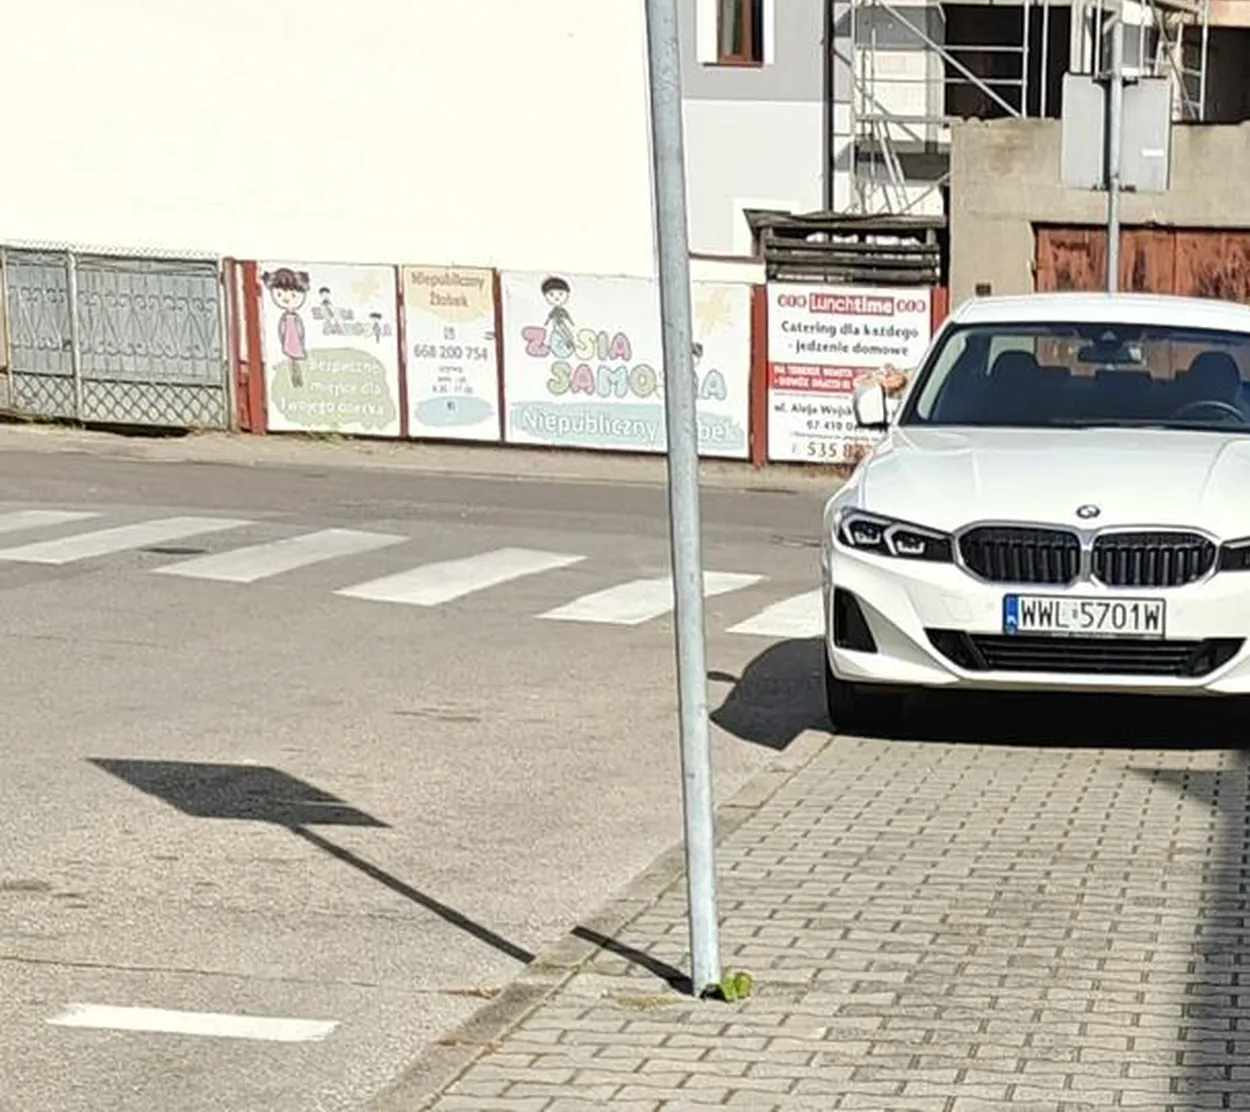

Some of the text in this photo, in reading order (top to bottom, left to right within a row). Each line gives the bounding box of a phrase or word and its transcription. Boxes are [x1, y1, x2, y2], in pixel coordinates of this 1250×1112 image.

[781, 320, 919, 341] Catering dla każdego
[414, 344, 489, 362] 668 200 754
[795, 339, 849, 354] jedzenie
[852, 341, 909, 357] domowe
[546, 359, 728, 402] SAMOA
[820, 404, 854, 419] Wojsk
[523, 405, 660, 441] Niepubliczny
[806, 441, 838, 458] 535
[1021, 600, 1160, 631] WWL 5701W
